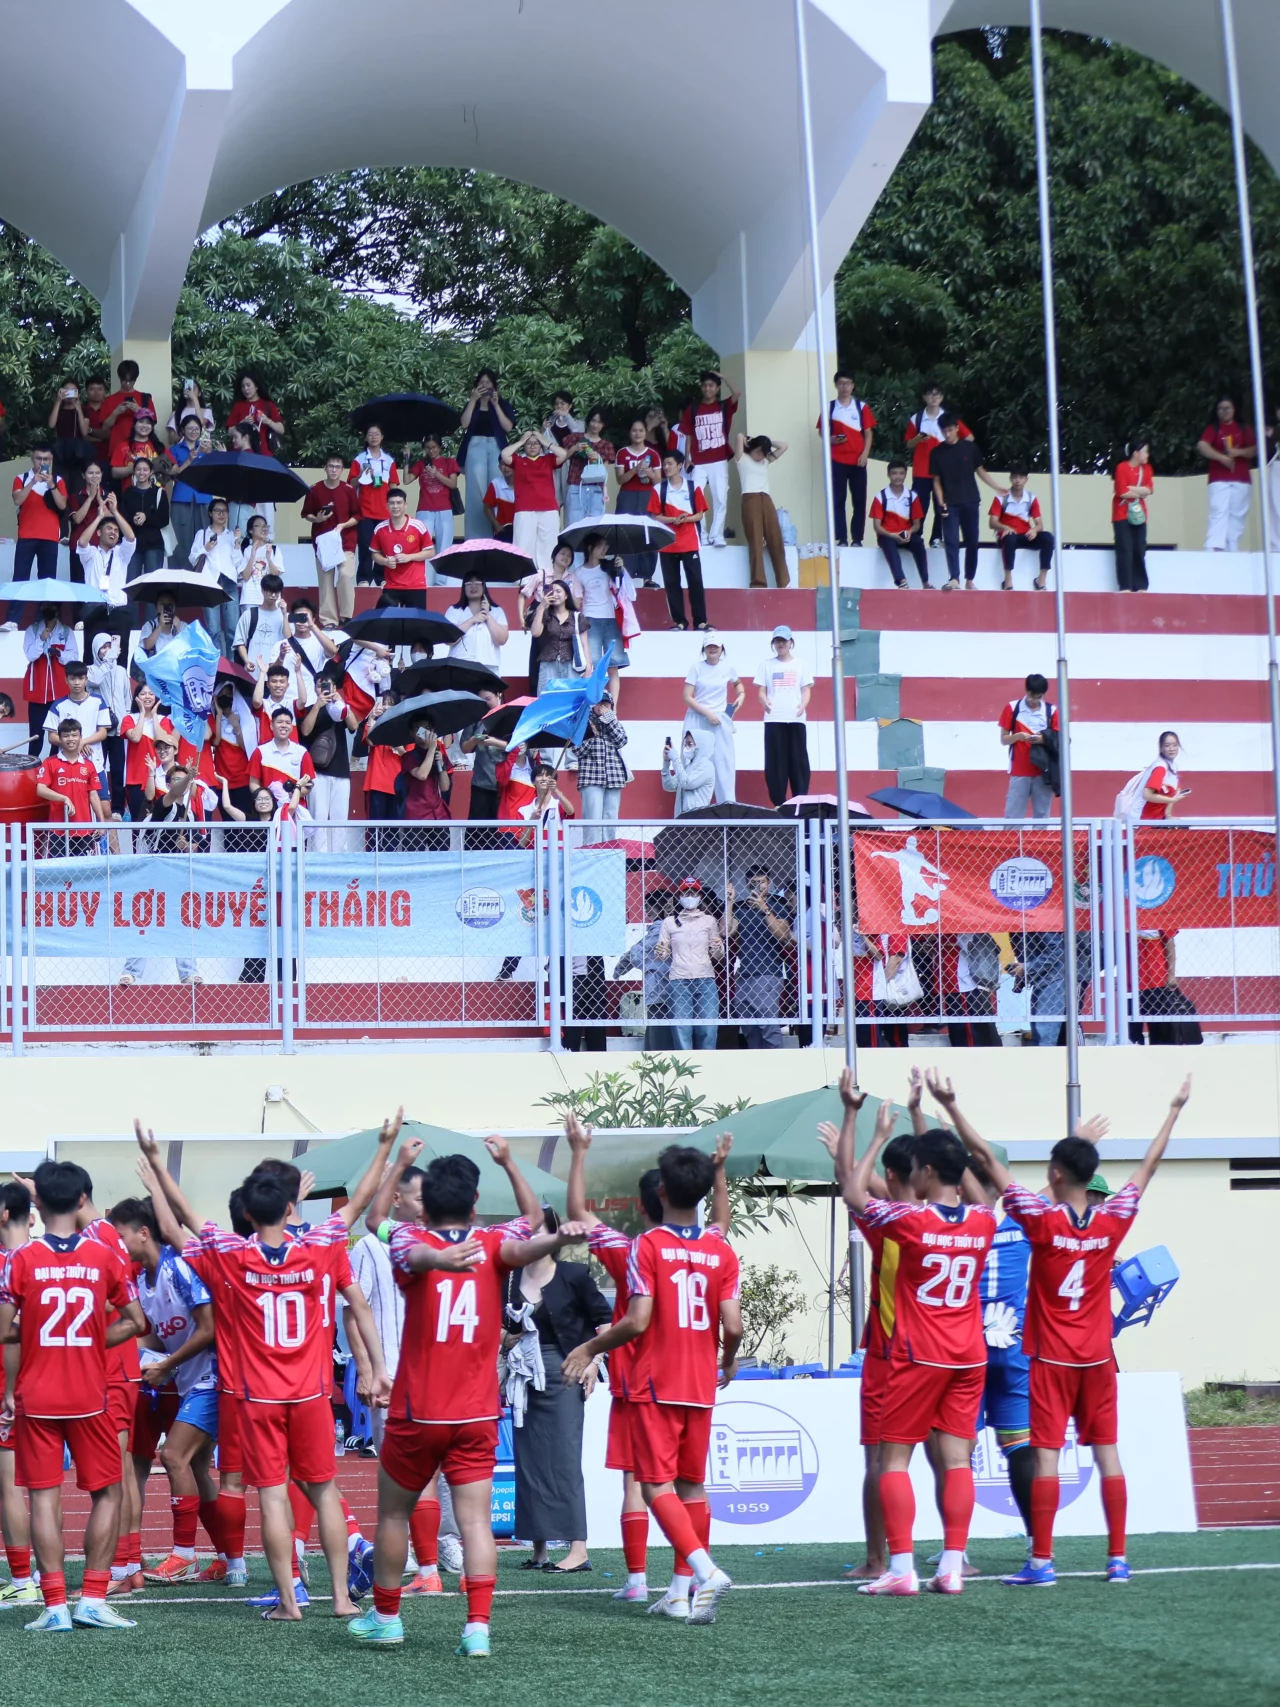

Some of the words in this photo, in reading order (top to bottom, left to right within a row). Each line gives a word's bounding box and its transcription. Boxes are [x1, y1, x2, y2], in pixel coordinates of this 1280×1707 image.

[1216, 852, 1276, 898] THỦ
[114, 886, 166, 935] LỢI
[304, 878, 411, 927] THẮNG
[261, 1274, 278, 1287] HỌC
[669, 1268, 710, 1331] 18
[916, 1253, 977, 1308] 28
[1057, 1259, 1086, 1311] 4
[39, 1286, 94, 1347] 22
[255, 1291, 306, 1348] 10
[437, 1278, 479, 1343] 14
[490, 1513, 511, 1522] EPSI
[491, 1500, 500, 1511] Ã
[726, 1502, 770, 1514] 1959
